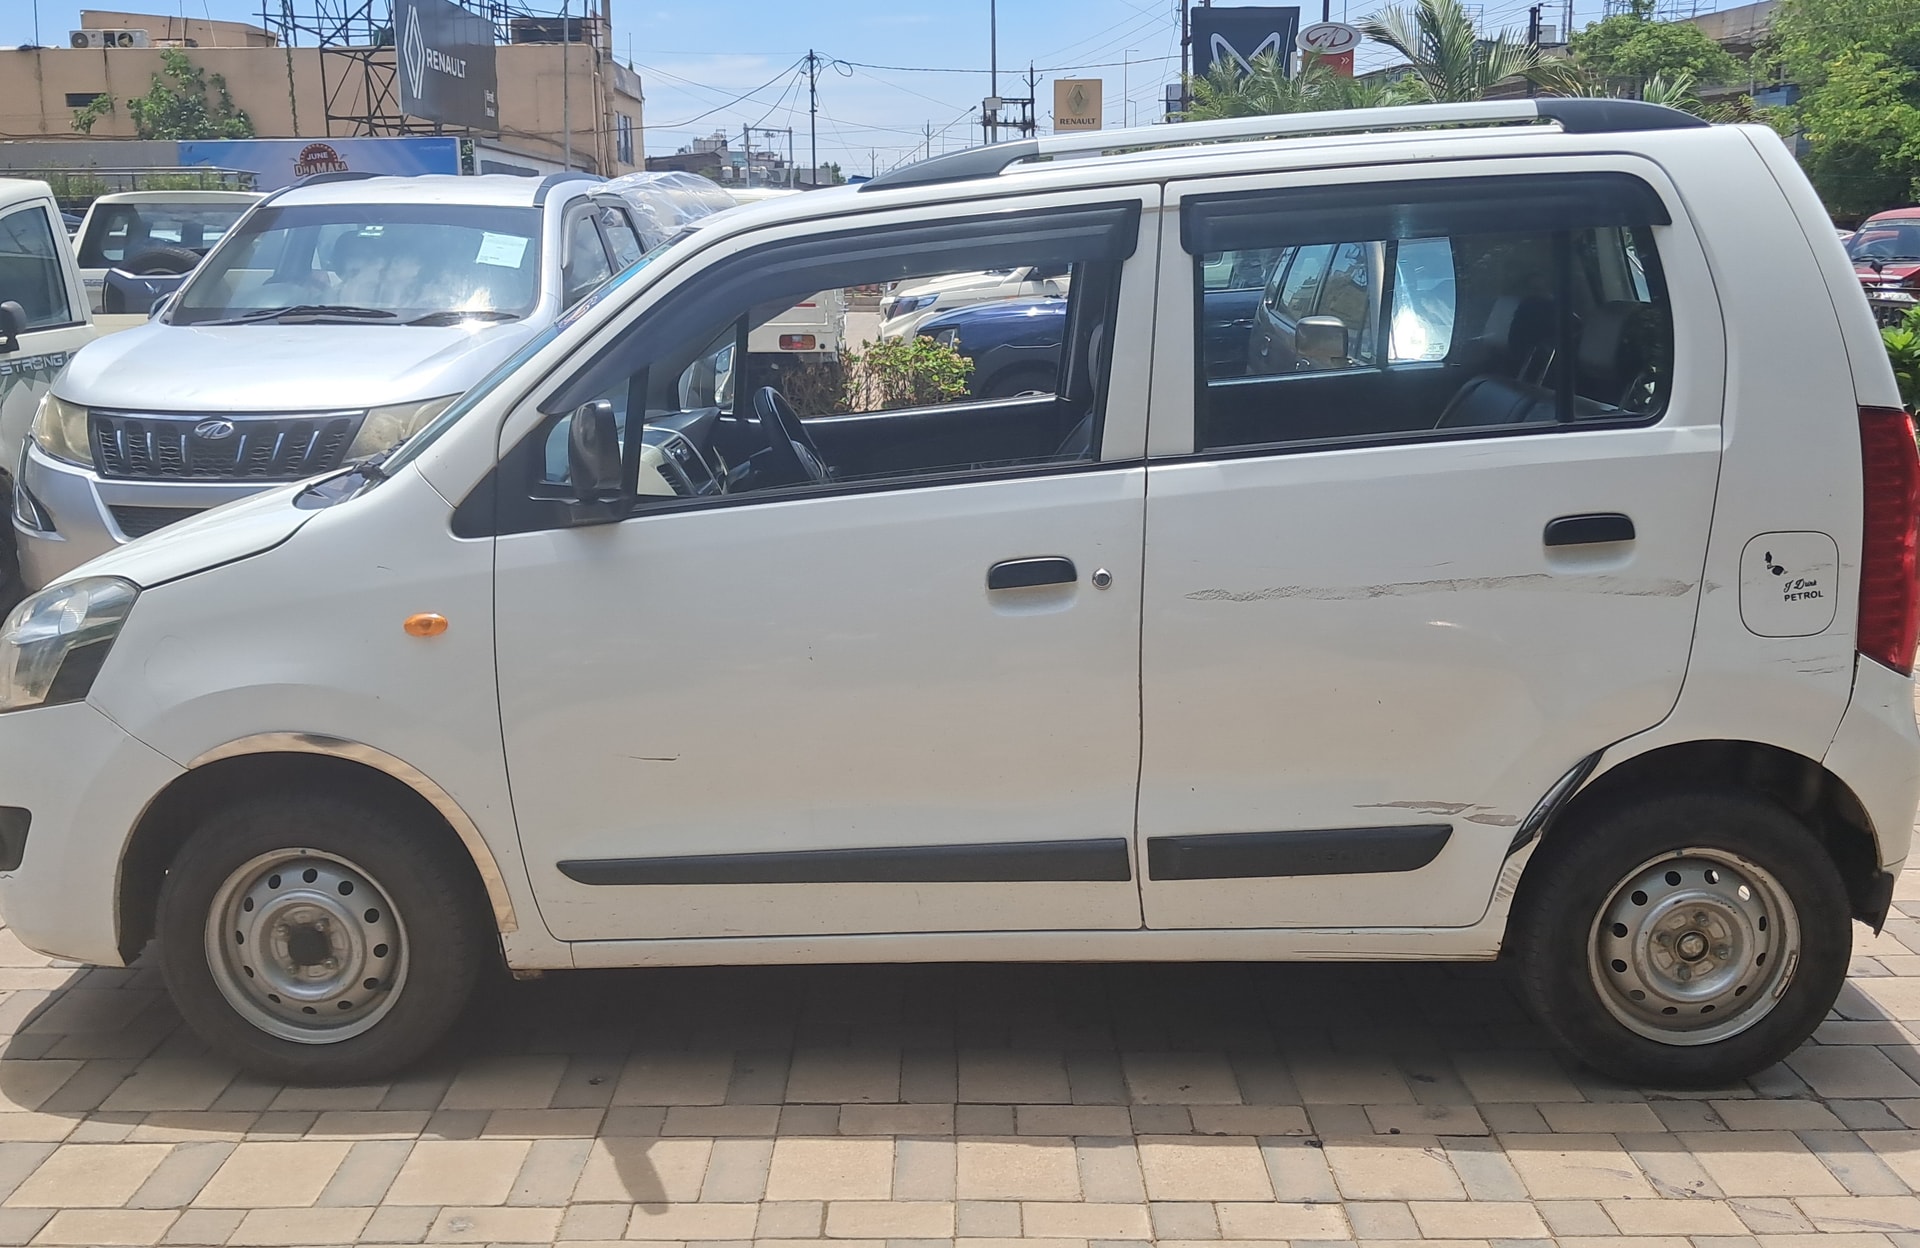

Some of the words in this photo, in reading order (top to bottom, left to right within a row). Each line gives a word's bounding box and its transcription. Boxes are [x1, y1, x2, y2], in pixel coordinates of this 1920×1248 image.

[426, 48, 466, 78] RENAULT
[1060, 117, 1096, 125] RENAULT
[306, 151, 329, 161] JUNE
[294, 161, 348, 176] DHAMAKA
[0, 354, 63, 375] STRONG
[1784, 590, 1824, 602] PETROL
